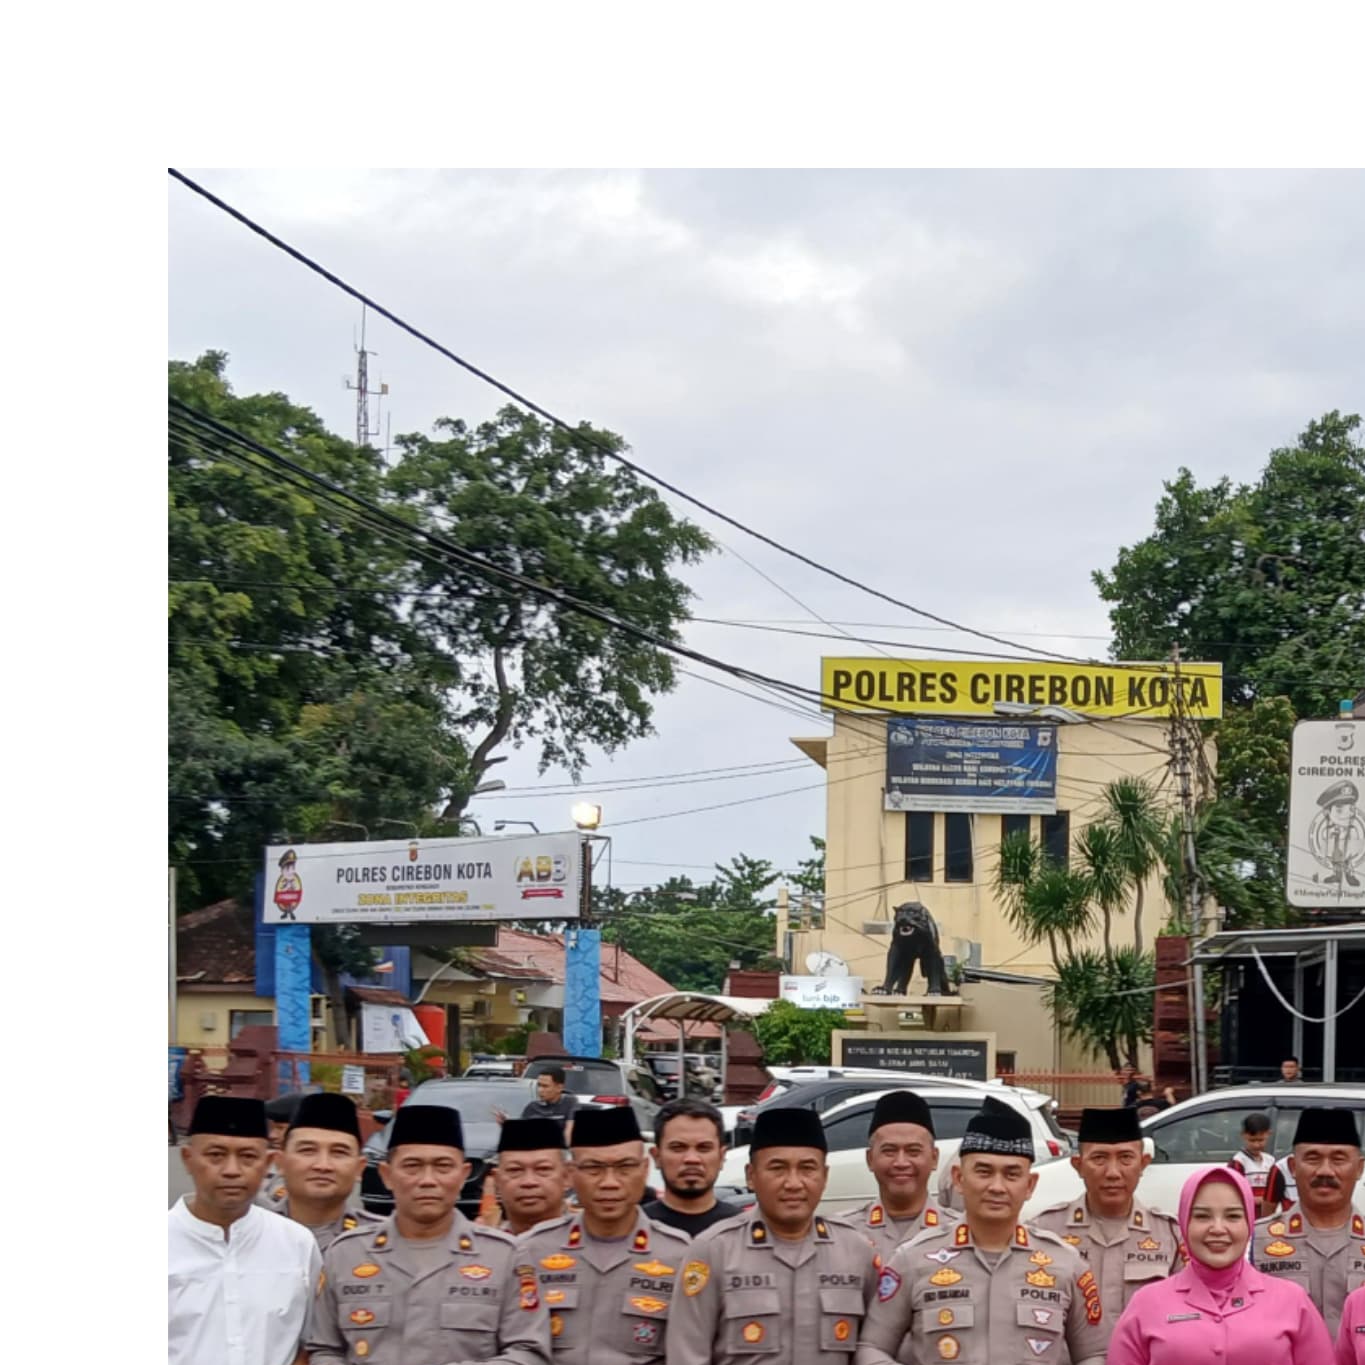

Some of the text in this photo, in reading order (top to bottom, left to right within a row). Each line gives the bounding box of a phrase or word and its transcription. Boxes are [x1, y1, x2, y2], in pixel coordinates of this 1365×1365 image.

[833, 670, 957, 702] POLRES
[970, 674, 1114, 706] CIREBON
[1298, 766, 1353, 777] CIREBON
[337, 861, 492, 883] POLRES CIREBON KOTA
[1127, 1252, 1168, 1263] POLRI
[630, 1277, 674, 1293] POLRI
[731, 1275, 771, 1288] DIDI
[819, 1274, 861, 1286] POLRI
[449, 1286, 497, 1297] POLRI
[1020, 1288, 1061, 1301] POLRI
